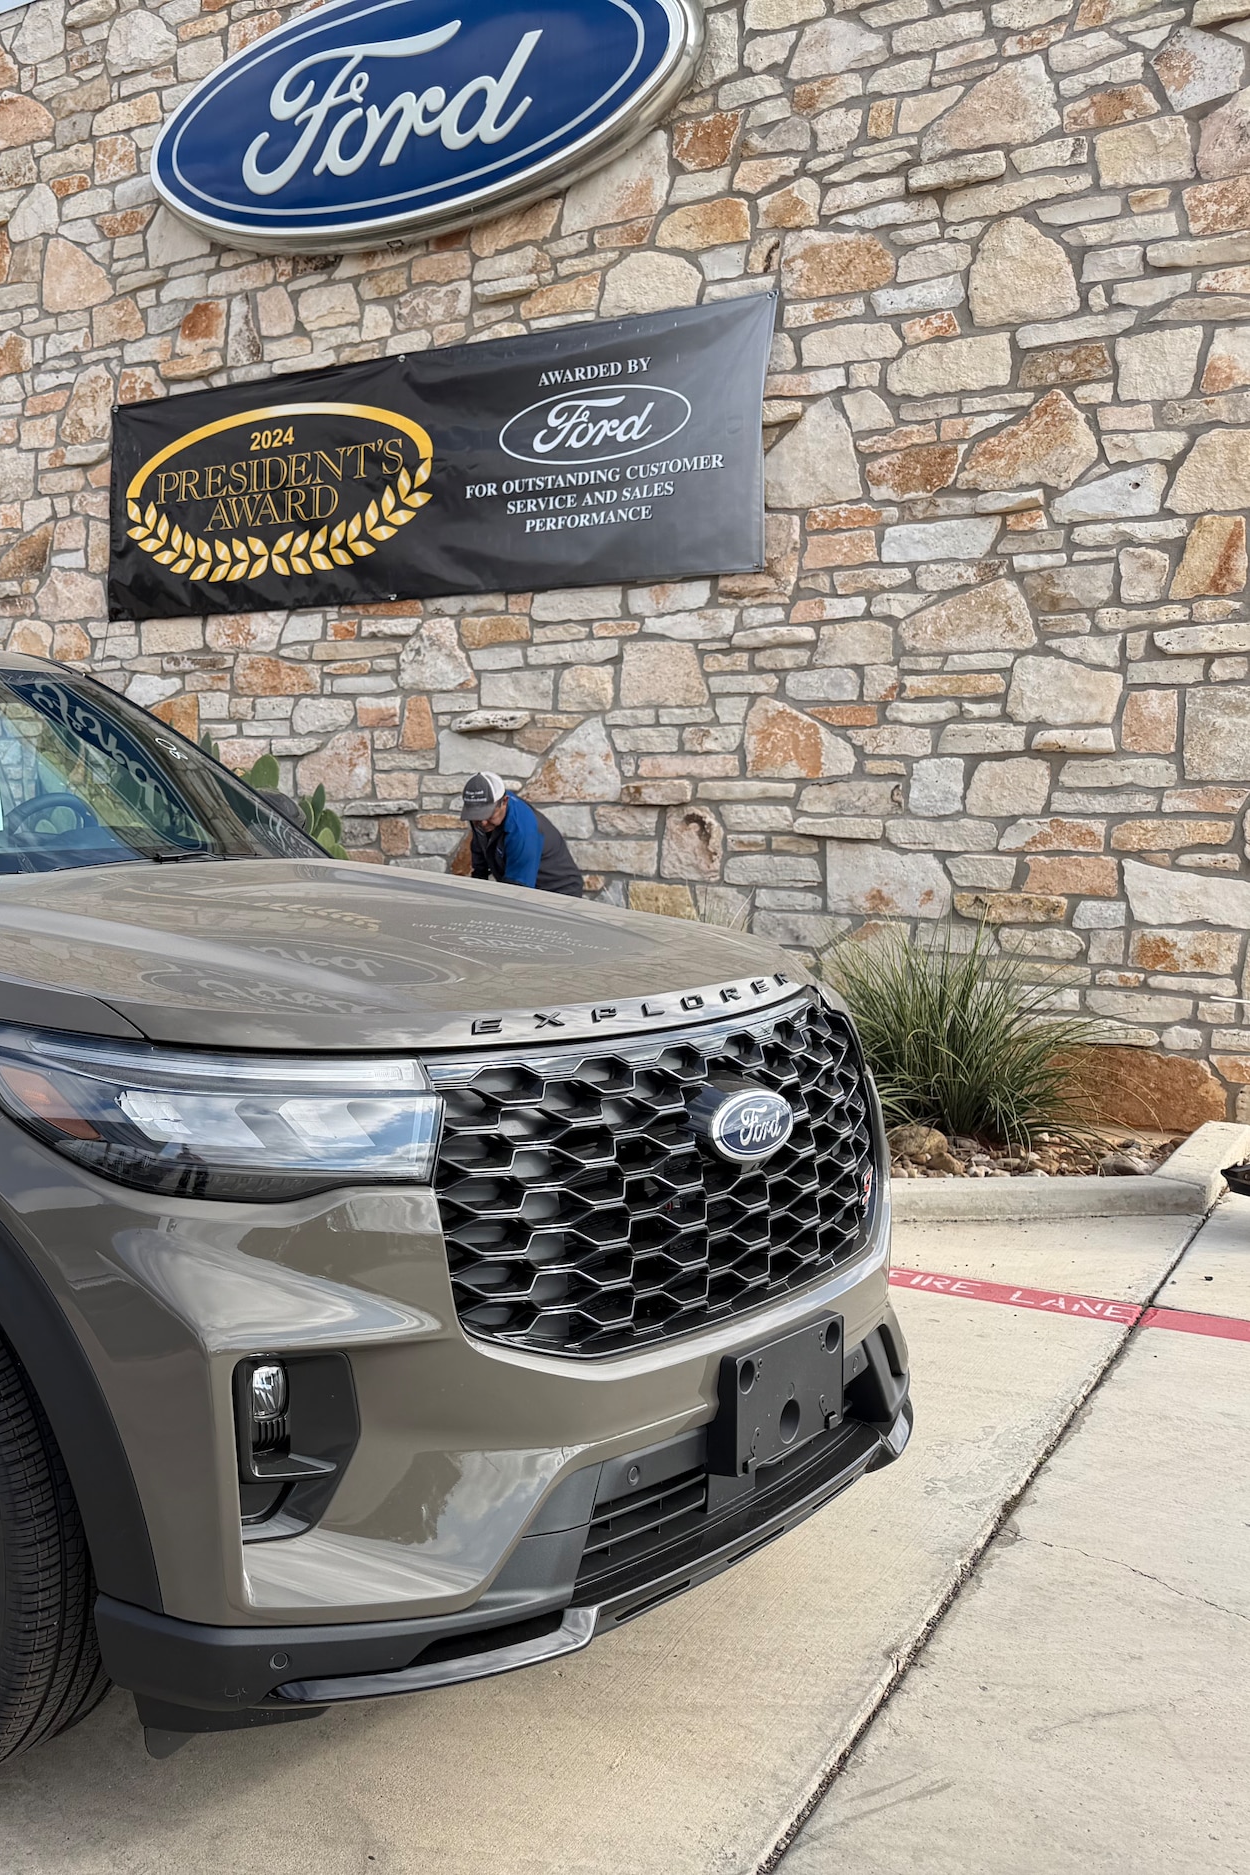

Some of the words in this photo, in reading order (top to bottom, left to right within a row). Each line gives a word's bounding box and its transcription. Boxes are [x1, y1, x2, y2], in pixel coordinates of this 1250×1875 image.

[242, 19, 543, 197] Ford
[538, 361, 623, 387] AWARDED
[627, 356, 652, 374] BY
[250, 426, 295, 451] 2024
[532, 395, 655, 453] Ford
[156, 438, 404, 505] PRESIDENT'S
[465, 483, 499, 499] FOR
[502, 467, 621, 496] OUTSTANDING
[625, 453, 725, 481] CUSTOMER
[203, 484, 339, 532] AWARD
[506, 494, 577, 515] SERVICE
[581, 489, 618, 507] AND
[621, 480, 675, 502] SALES
[524, 505, 653, 534] PERFORMANCE
[471, 970, 792, 1036] EXPLORER
[739, 1105, 782, 1147] Ford
[889, 1269, 982, 1295] FIRE
[1009, 1290, 1138, 1320] LANE
